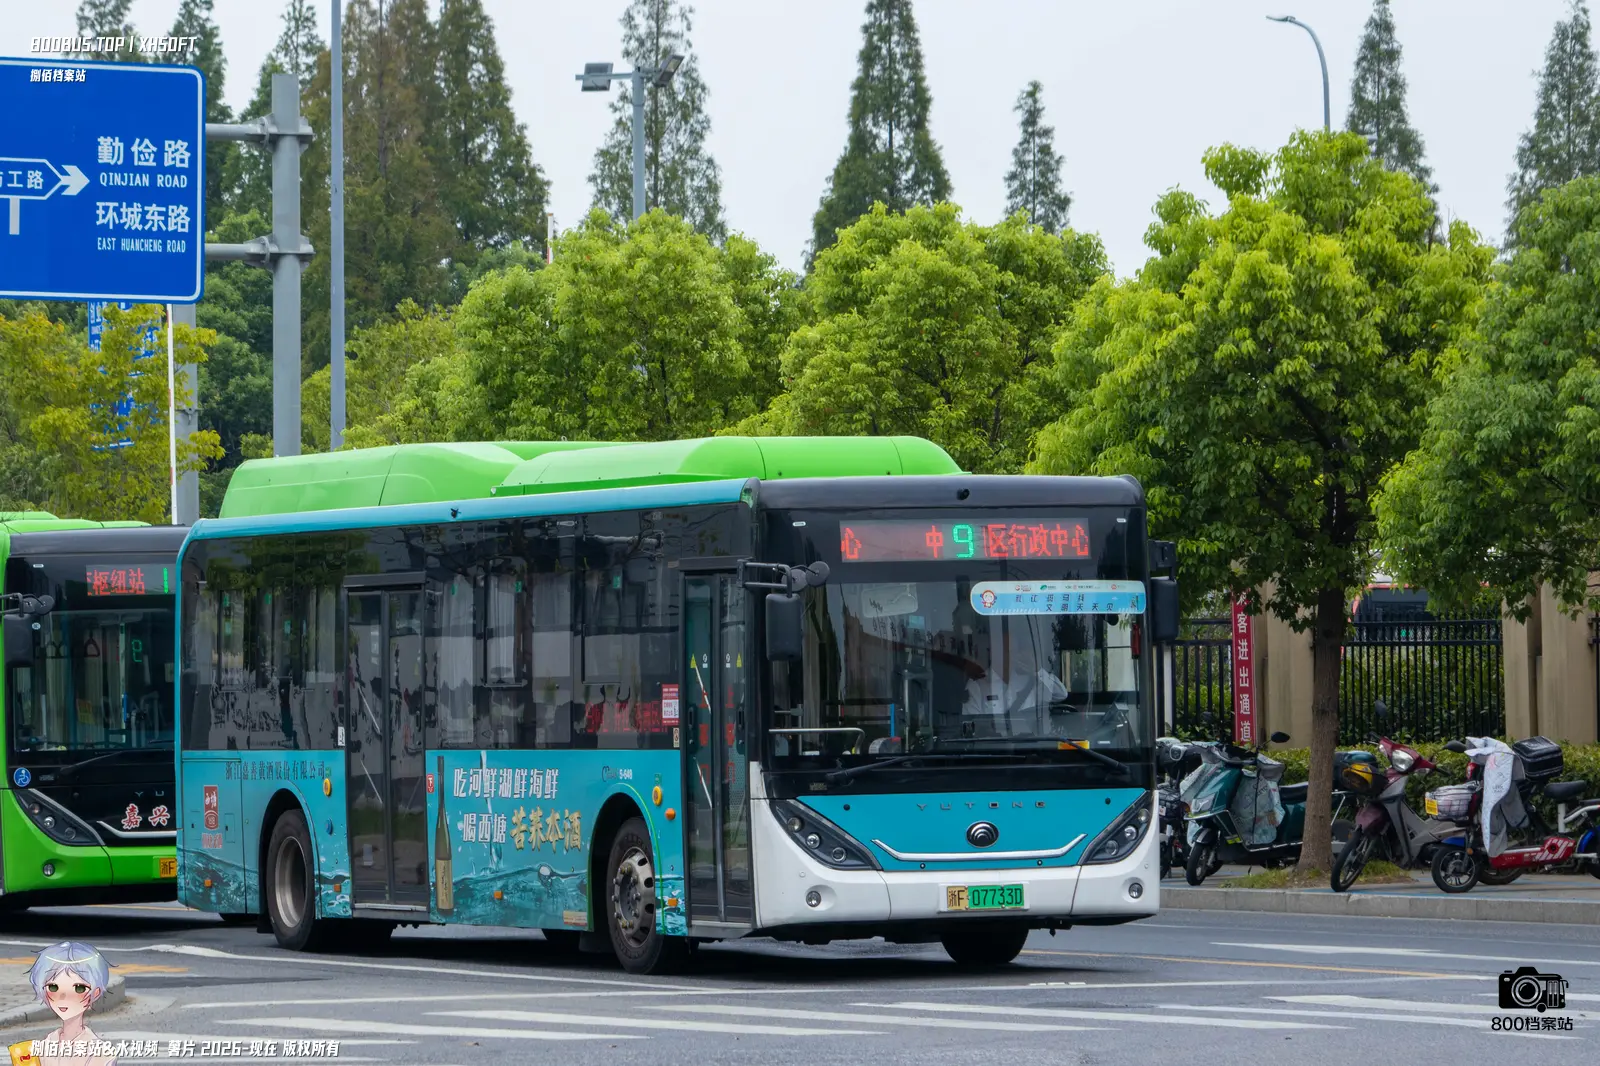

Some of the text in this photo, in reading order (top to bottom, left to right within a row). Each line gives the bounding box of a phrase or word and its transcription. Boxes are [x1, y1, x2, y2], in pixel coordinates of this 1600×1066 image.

[97, 136, 191, 168] 勤俭路
[100, 172, 188, 188] QINJIAN ROAD
[96, 201, 191, 233] 环城东路
[97, 237, 186, 253] EAST HUANCHENG ROAD
[926, 525, 943, 558] 中
[952, 524, 974, 558] 9
[225, 760, 325, 780] 浙江嘉善黄酒股份有限公司
[453, 768, 559, 799] 吃河鲜湖鲜海鲜
[121, 803, 170, 829] 嘉兴
[917, 801, 1046, 811] YUTONG
[463, 813, 507, 844] 喝西塘
[972, 888, 1023, 906] 07733D
